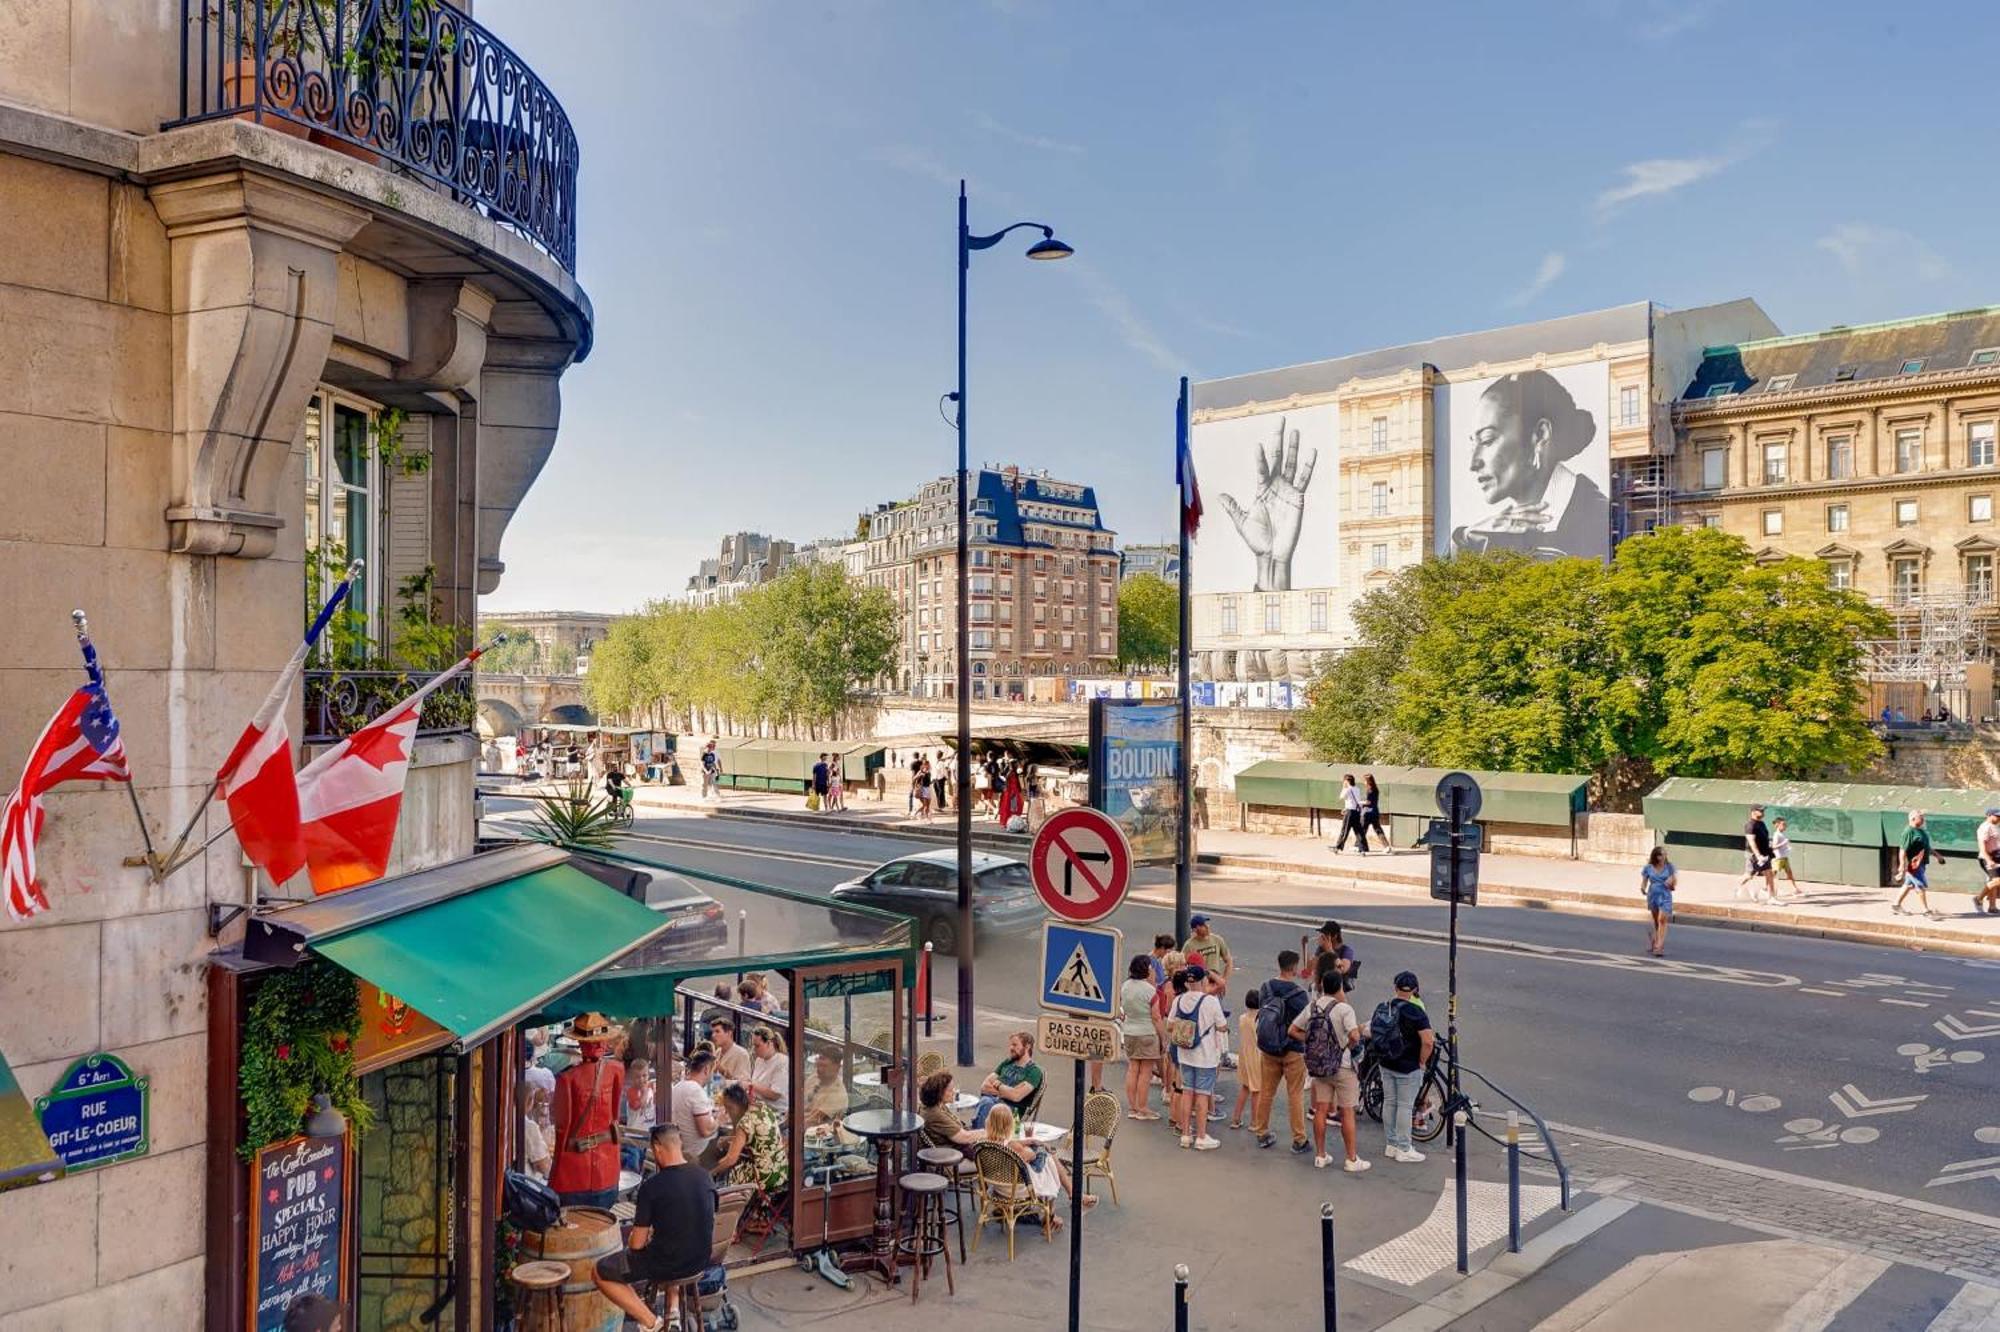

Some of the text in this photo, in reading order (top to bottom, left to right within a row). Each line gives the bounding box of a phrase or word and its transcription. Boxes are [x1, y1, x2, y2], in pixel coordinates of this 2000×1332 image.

[1109, 747, 1174, 780] BOUDIN
[1048, 1022, 1106, 1041] PASSAGE
[82, 1101, 107, 1120] RUE
[263, 1161, 280, 1180] The
[286, 1170, 317, 1201] PUB
[275, 1193, 326, 1230] SPECIALS
[261, 1207, 336, 1254] HAPPY HOUR
[296, 1276, 310, 1295] all
[311, 1272, 333, 1295] day
